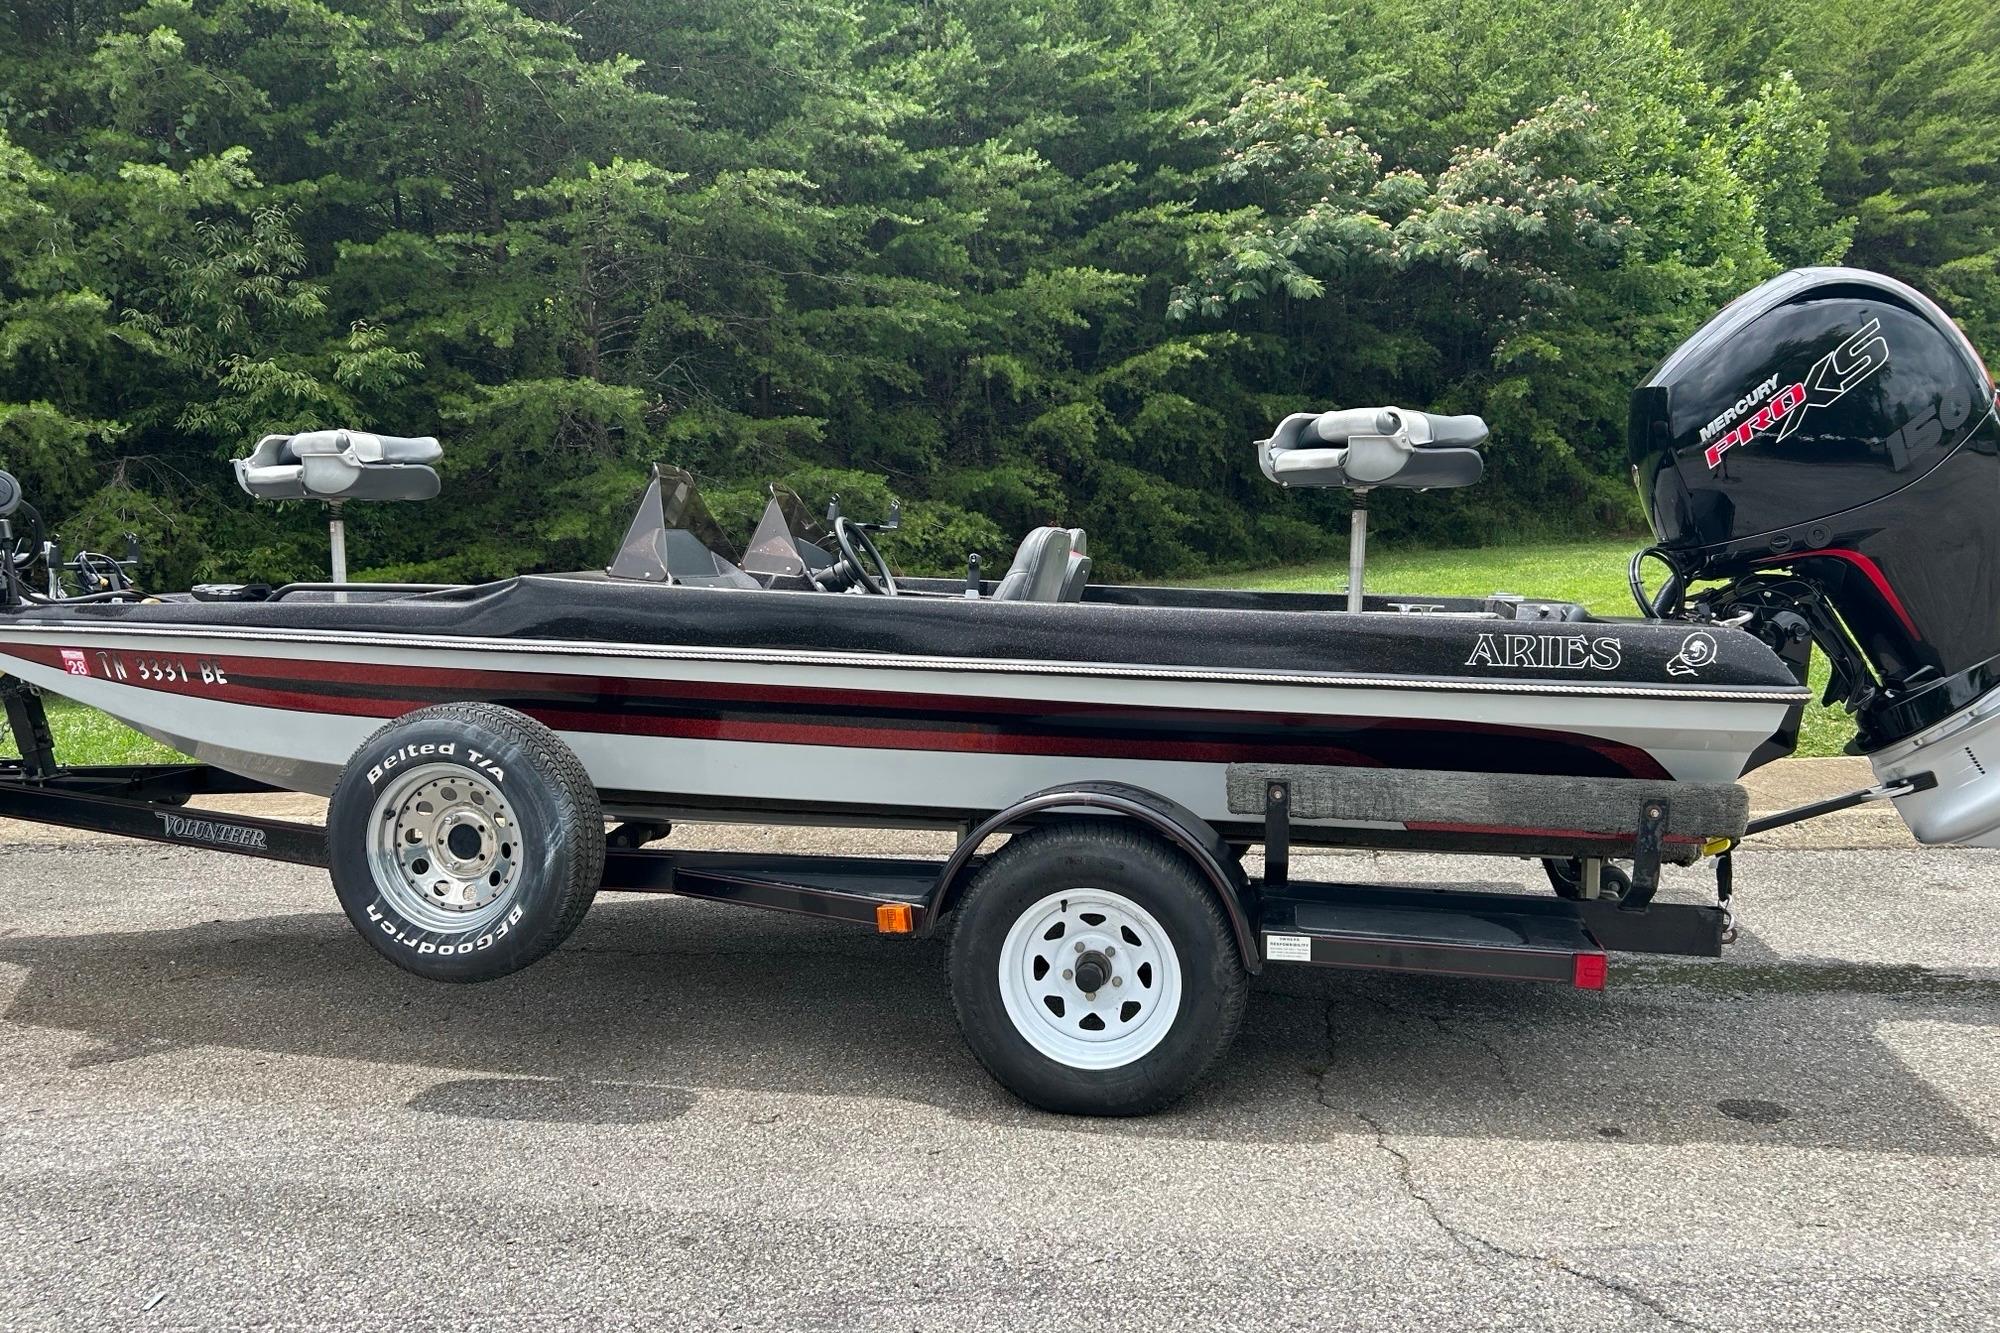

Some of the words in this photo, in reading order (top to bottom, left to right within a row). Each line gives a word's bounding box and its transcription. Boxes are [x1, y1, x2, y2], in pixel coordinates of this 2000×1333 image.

[1699, 372, 1779, 442] MERCURY
[1886, 388, 1971, 472] 150
[68, 660, 87, 675] 28
[96, 651, 128, 680] TN
[136, 656, 189, 682] 3331
[198, 656, 228, 685] BE
[1464, 633, 1622, 670] ARIES
[366, 743, 456, 785] Belted
[467, 749, 505, 782] T/A
[155, 811, 268, 849] VOLUNTEER
[366, 904, 524, 956] BFGoodrich
